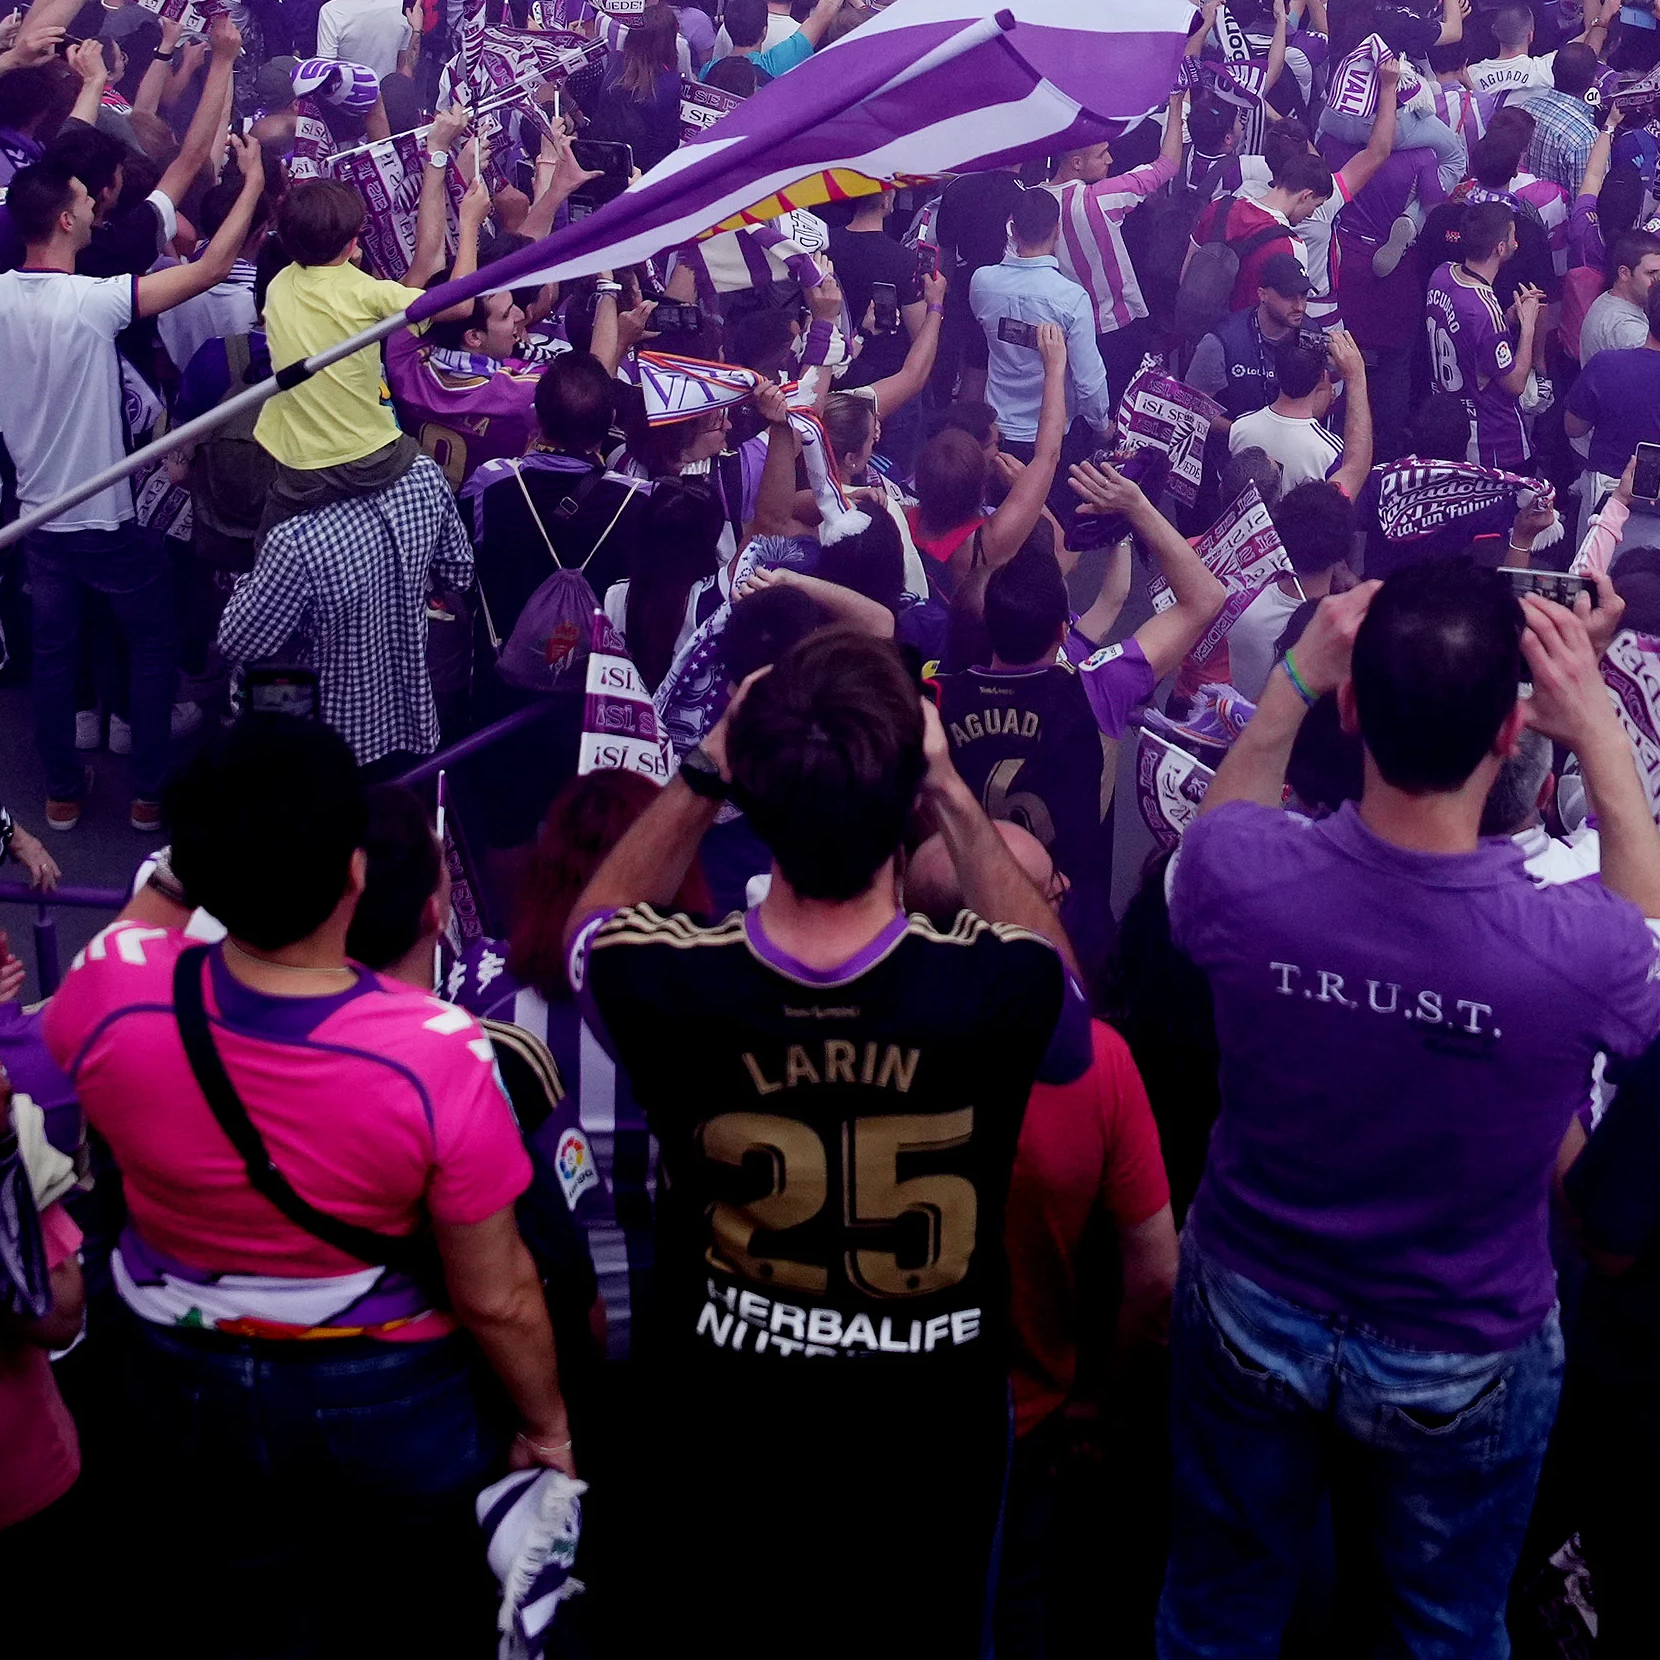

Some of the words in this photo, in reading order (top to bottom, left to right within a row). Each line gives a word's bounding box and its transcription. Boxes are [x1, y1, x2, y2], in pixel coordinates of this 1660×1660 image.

[1480, 70, 1530, 90] AGUADO
[1247, 367, 1275, 378] LaLa
[950, 708, 1042, 748] AGUAD
[1268, 961, 1504, 1039] T.R.U.S.T.
[742, 1039, 921, 1094] LARIN
[695, 1105, 980, 1300] 25
[706, 1278, 983, 1357] HERBALIFE
